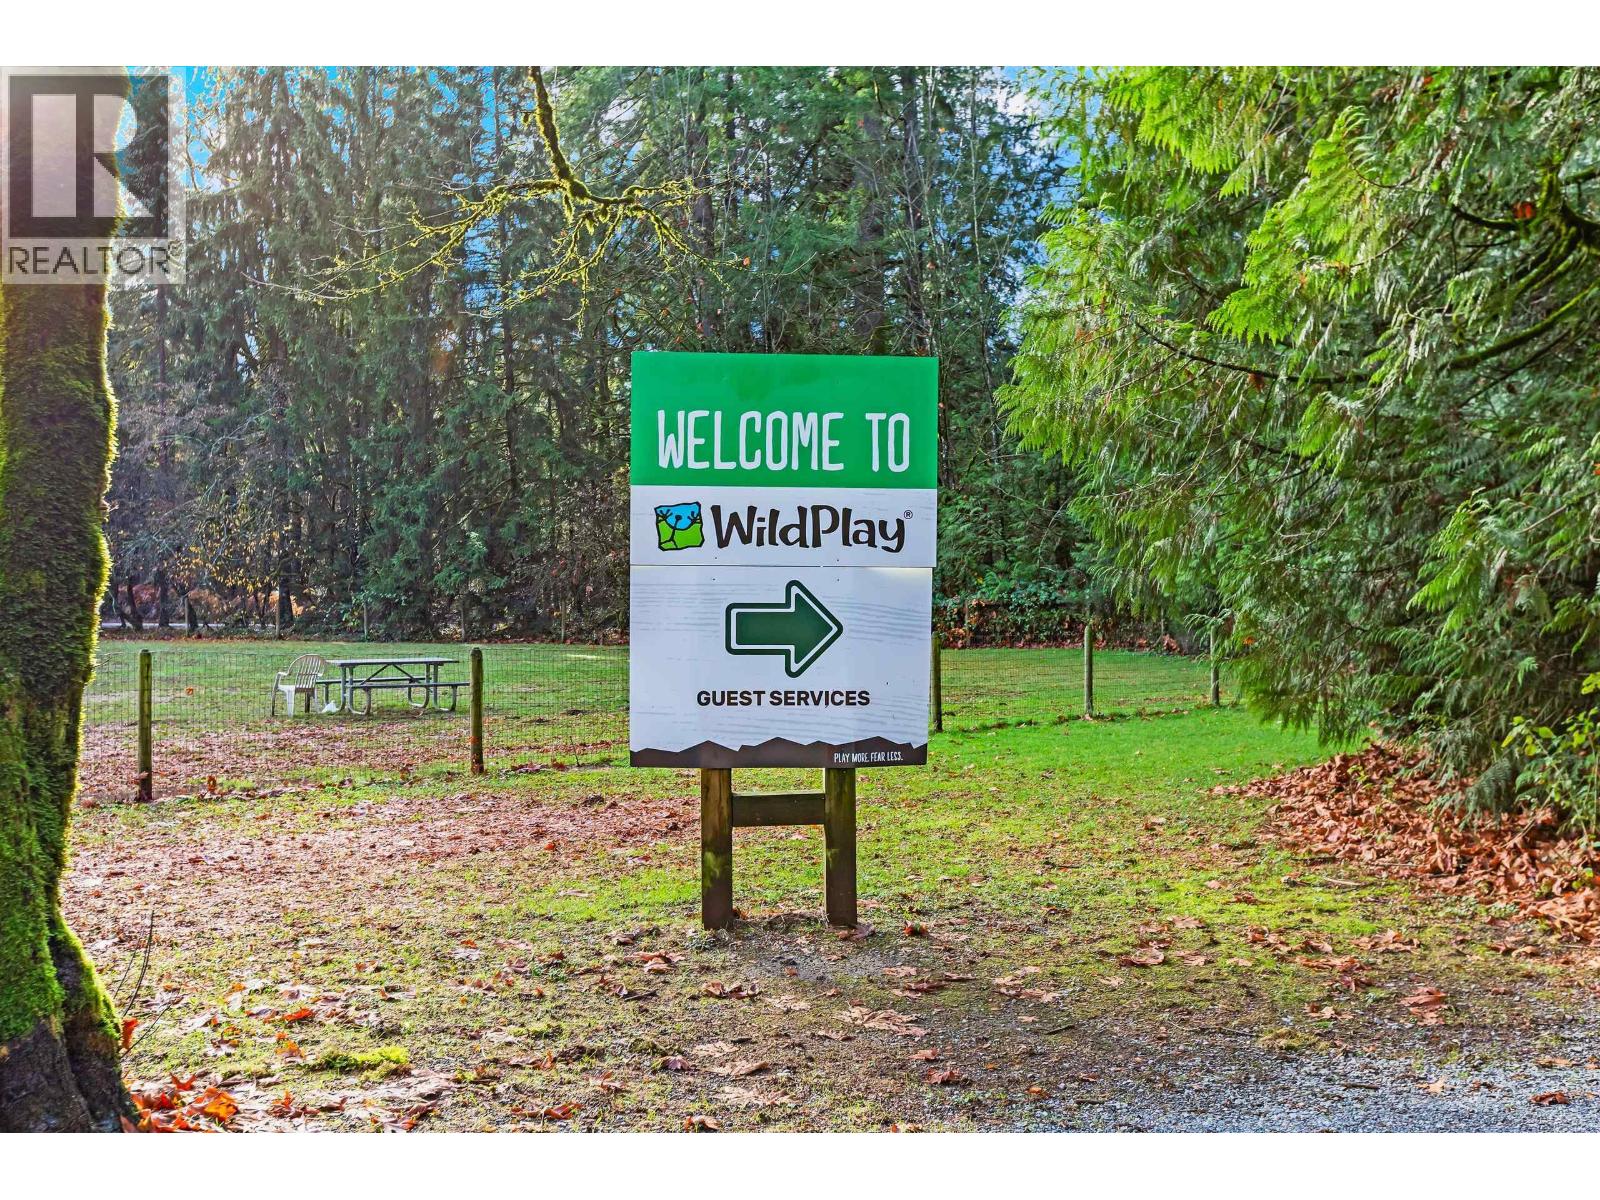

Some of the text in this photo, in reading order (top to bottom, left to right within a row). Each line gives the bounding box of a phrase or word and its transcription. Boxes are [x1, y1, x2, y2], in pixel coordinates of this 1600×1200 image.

[657, 410, 910, 473] WELCOME TO
[697, 690, 870, 706] GUEST SERVICES
[834, 752, 850, 763] PLAY
[870, 752, 886, 762] FEAR
[887, 751, 904, 761] LESS.
